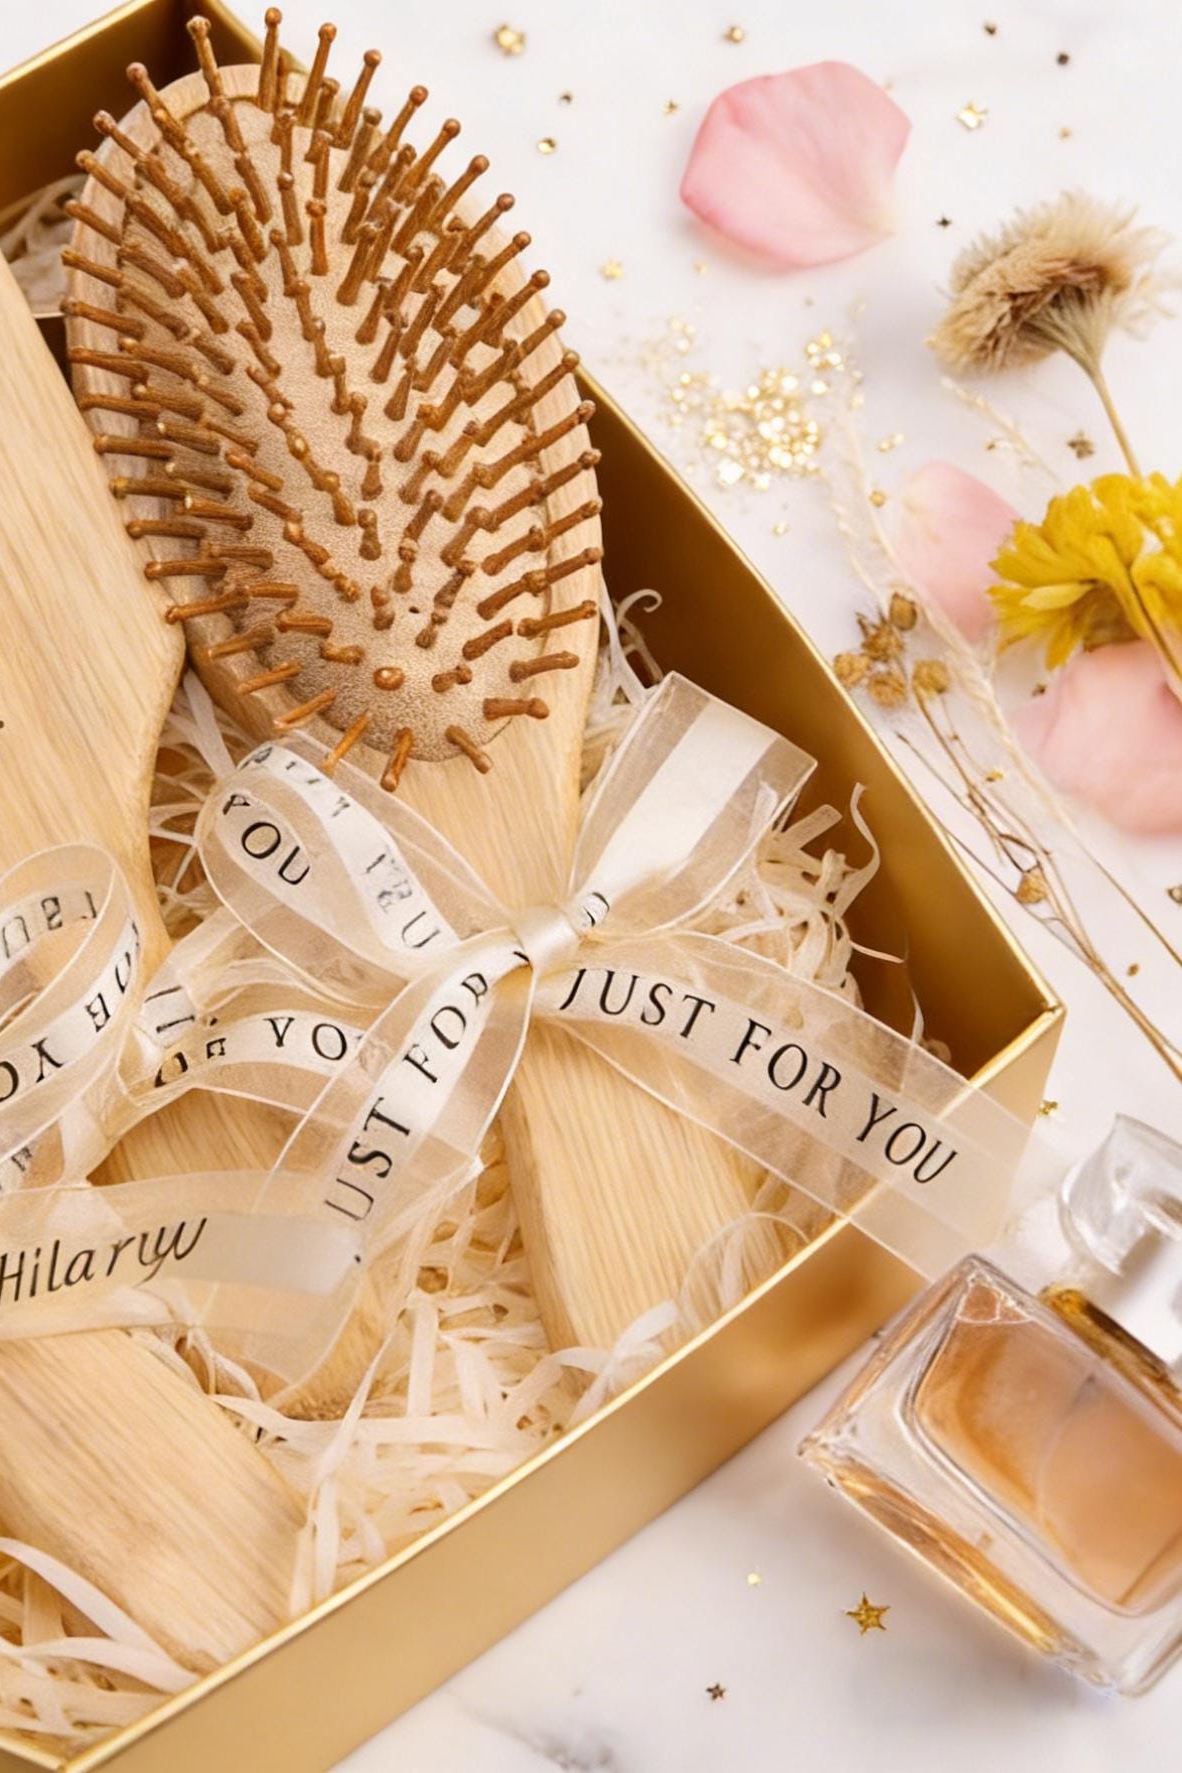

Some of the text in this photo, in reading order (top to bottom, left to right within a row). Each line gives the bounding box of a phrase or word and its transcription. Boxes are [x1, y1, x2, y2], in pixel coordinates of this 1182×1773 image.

[559, 968, 959, 1185] JUST FOR YOU
